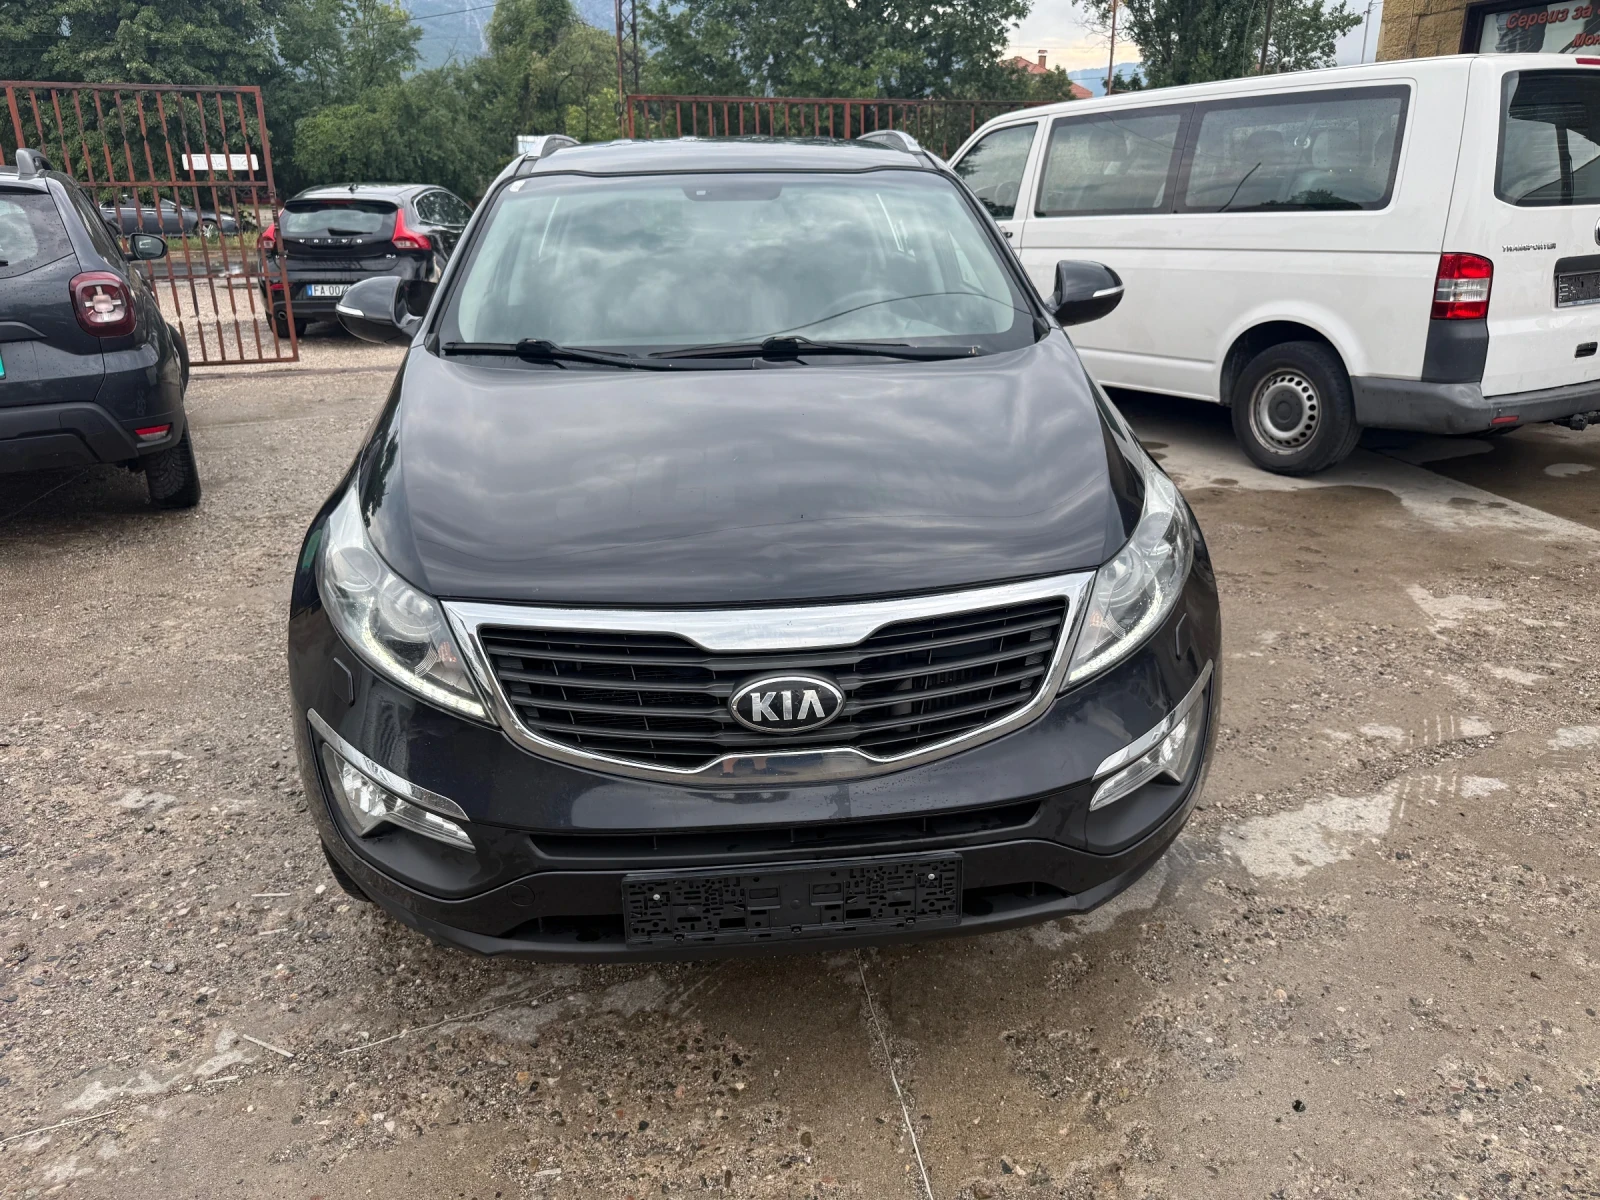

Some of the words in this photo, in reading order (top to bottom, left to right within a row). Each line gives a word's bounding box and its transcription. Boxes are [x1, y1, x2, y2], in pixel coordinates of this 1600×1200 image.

[1506, 8, 1570, 30] Сервиз
[1572, 4, 1593, 20] за
[1501, 242, 1557, 253] TRANSPORTER
[749, 689, 826, 722] KIA
